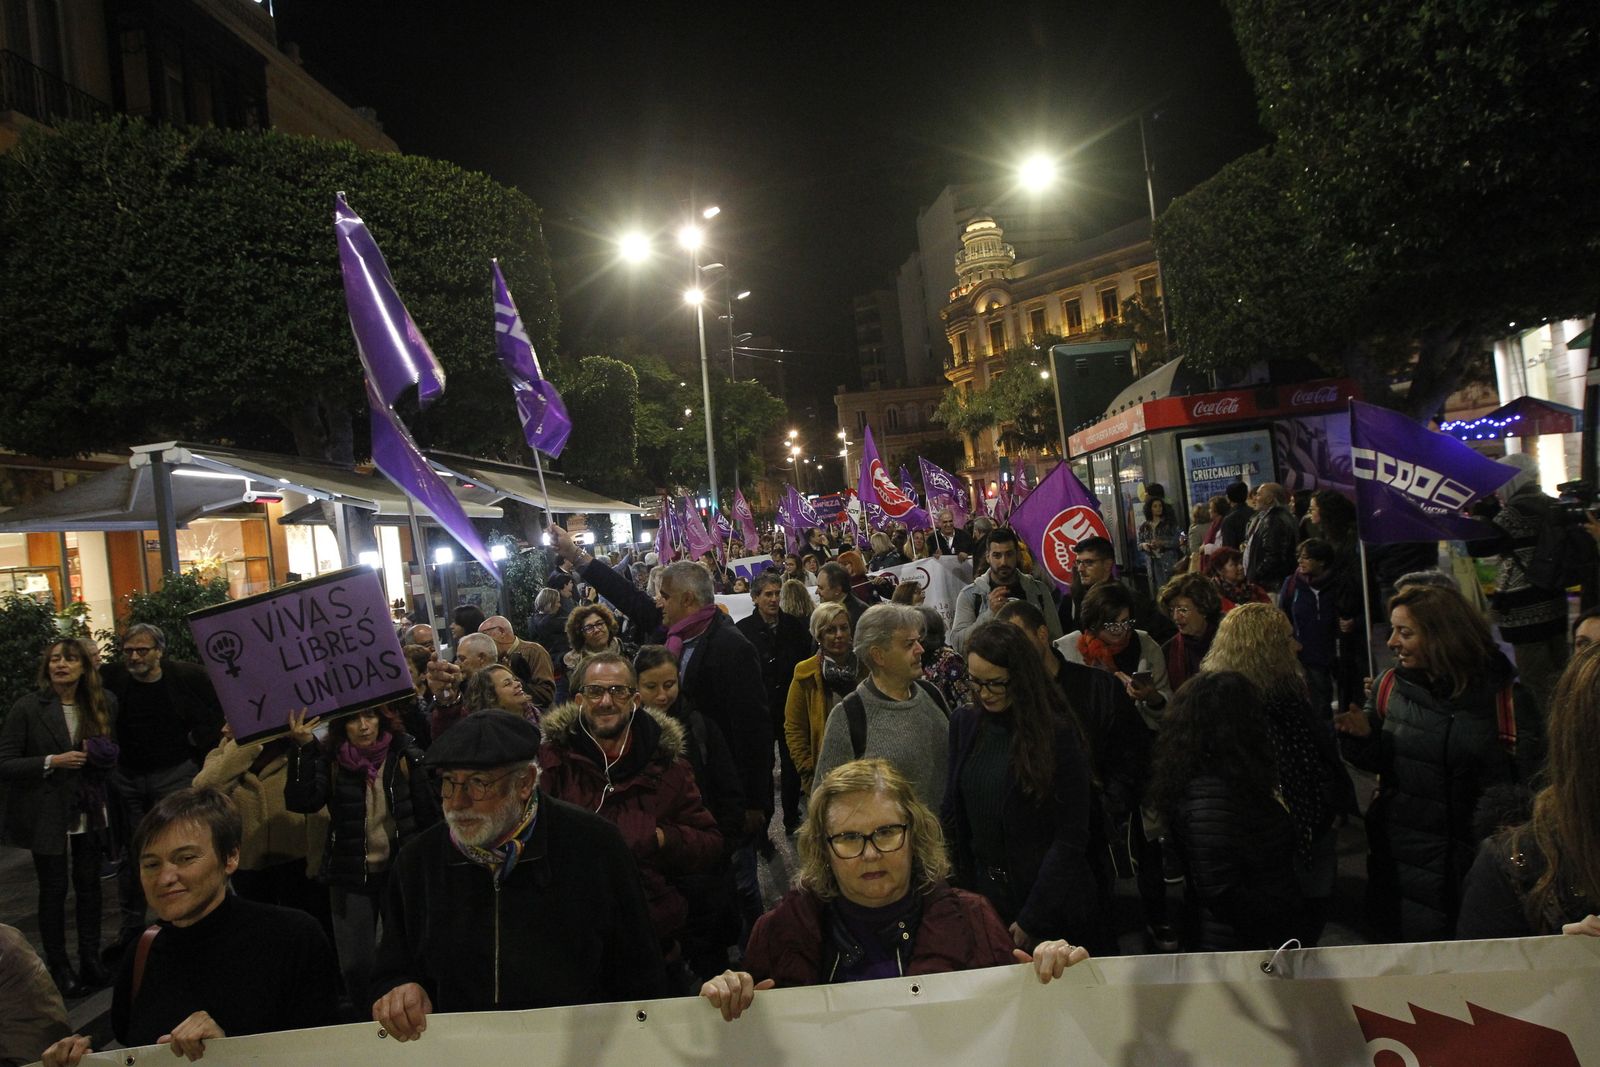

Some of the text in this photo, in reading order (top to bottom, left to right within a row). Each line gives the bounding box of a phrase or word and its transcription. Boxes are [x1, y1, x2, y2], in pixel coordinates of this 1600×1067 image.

[1191, 456, 1216, 469] NUEVA
[1192, 463, 1241, 482] CRUZCAMPO
[252, 586, 352, 643] VIVAS
[293, 650, 401, 706] UNIDAS
[248, 694, 266, 721] Y
